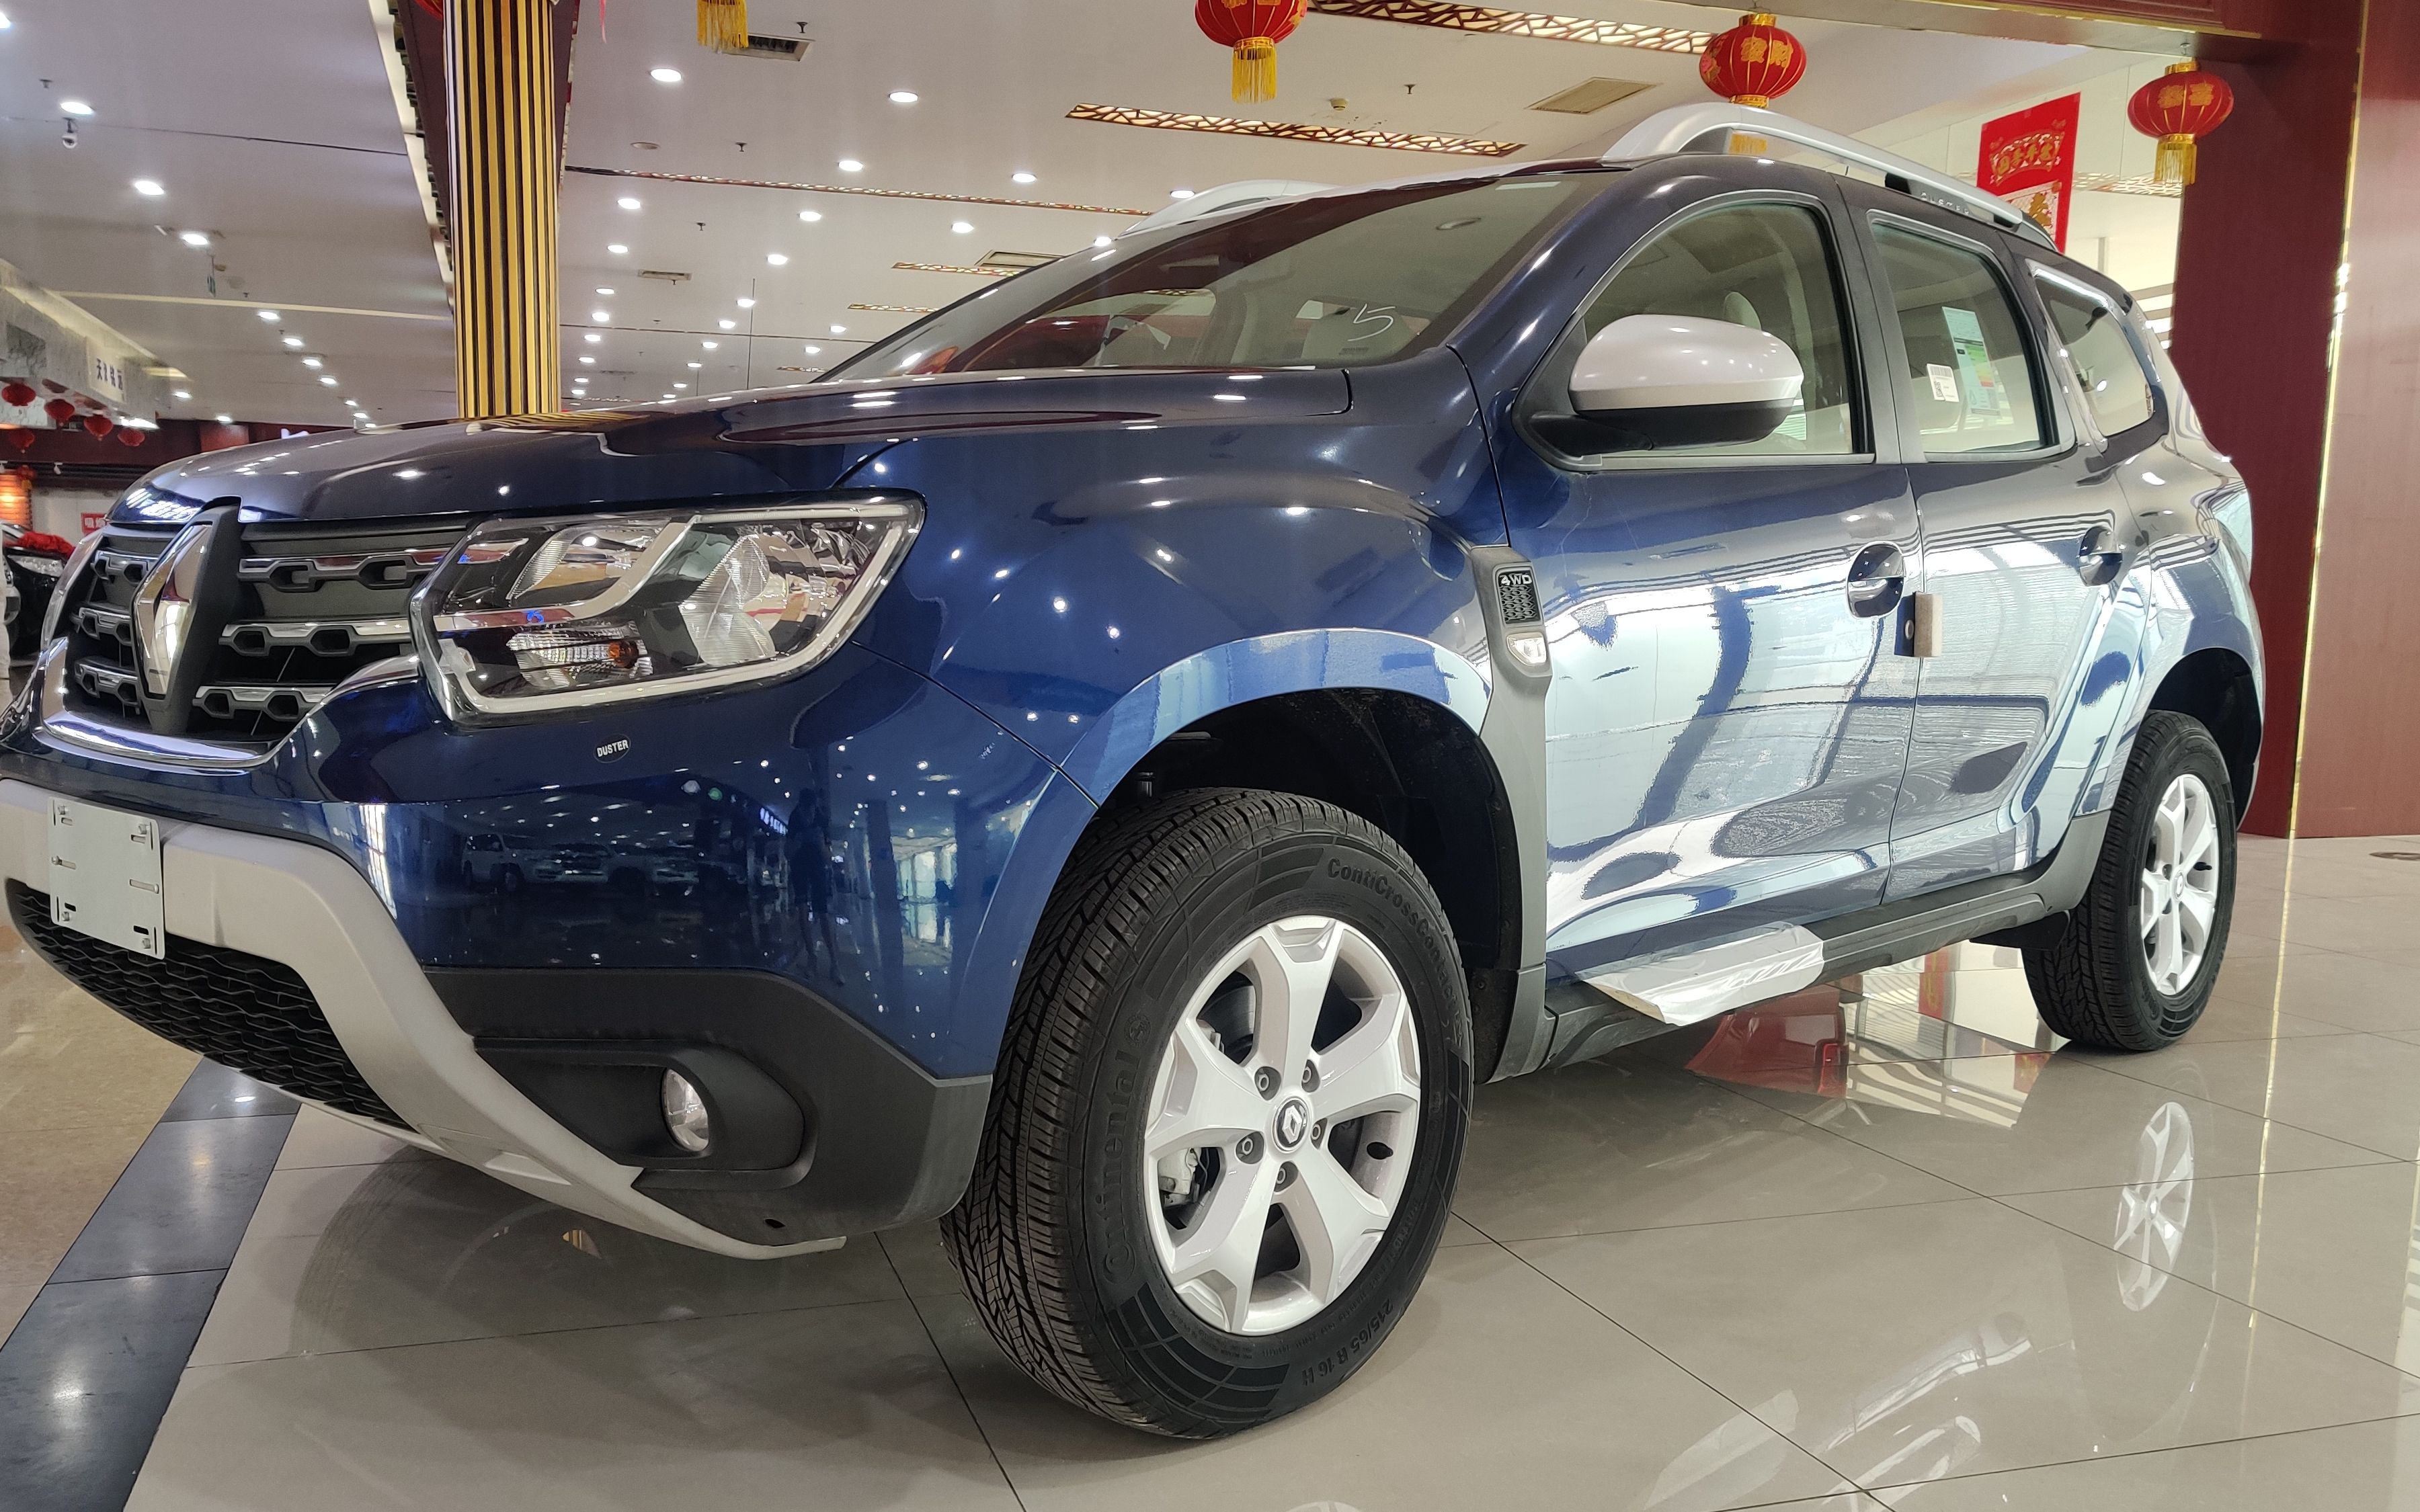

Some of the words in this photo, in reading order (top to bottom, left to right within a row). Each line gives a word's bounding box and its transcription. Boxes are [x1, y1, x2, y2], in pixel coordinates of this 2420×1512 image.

[1347, 303, 1396, 342] 5
[1500, 573, 1533, 586] 4WD
[597, 739, 629, 757] DUSTER
[1350, 1298, 1394, 1353] 215/65
[1336, 1347, 1348, 1364] R
[1318, 1357, 1335, 1376] 16
